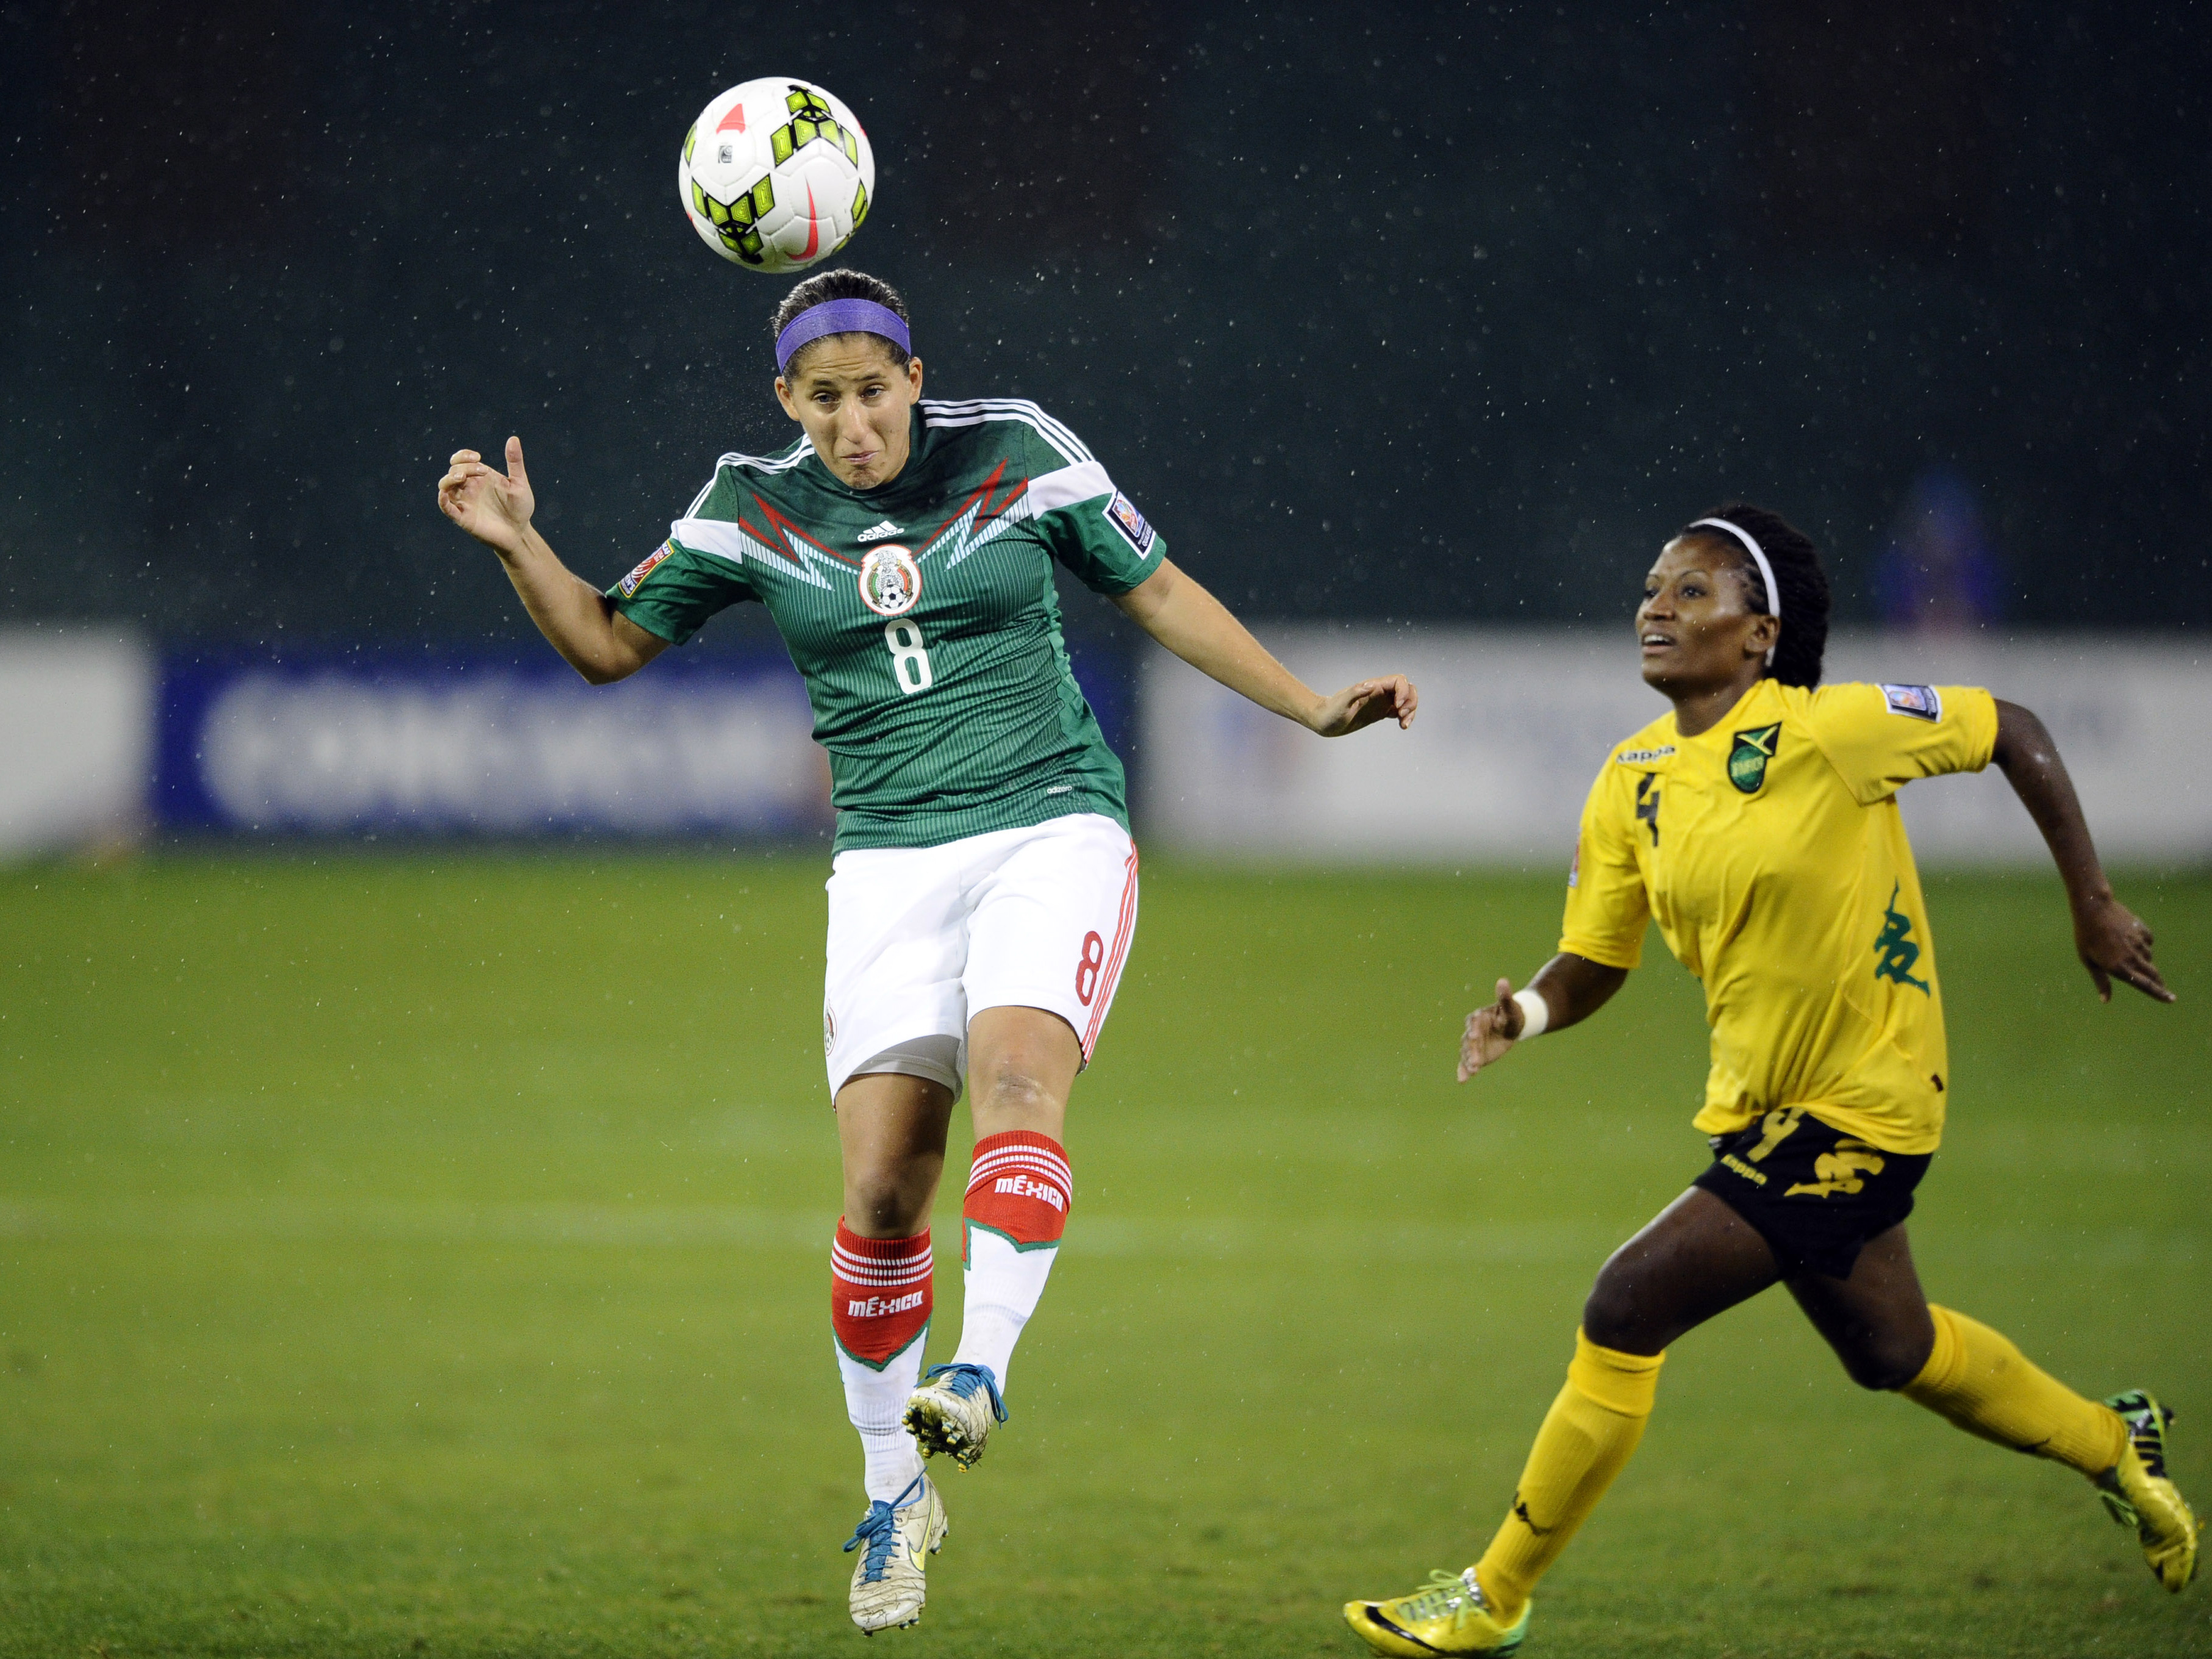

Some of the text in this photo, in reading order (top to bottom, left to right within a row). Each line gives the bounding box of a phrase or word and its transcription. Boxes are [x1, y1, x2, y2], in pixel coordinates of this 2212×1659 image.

[857, 528, 904, 542] adidas
[884, 618, 932, 695] 8
[1636, 772, 1660, 847] 4
[1075, 930, 1103, 1006] 8
